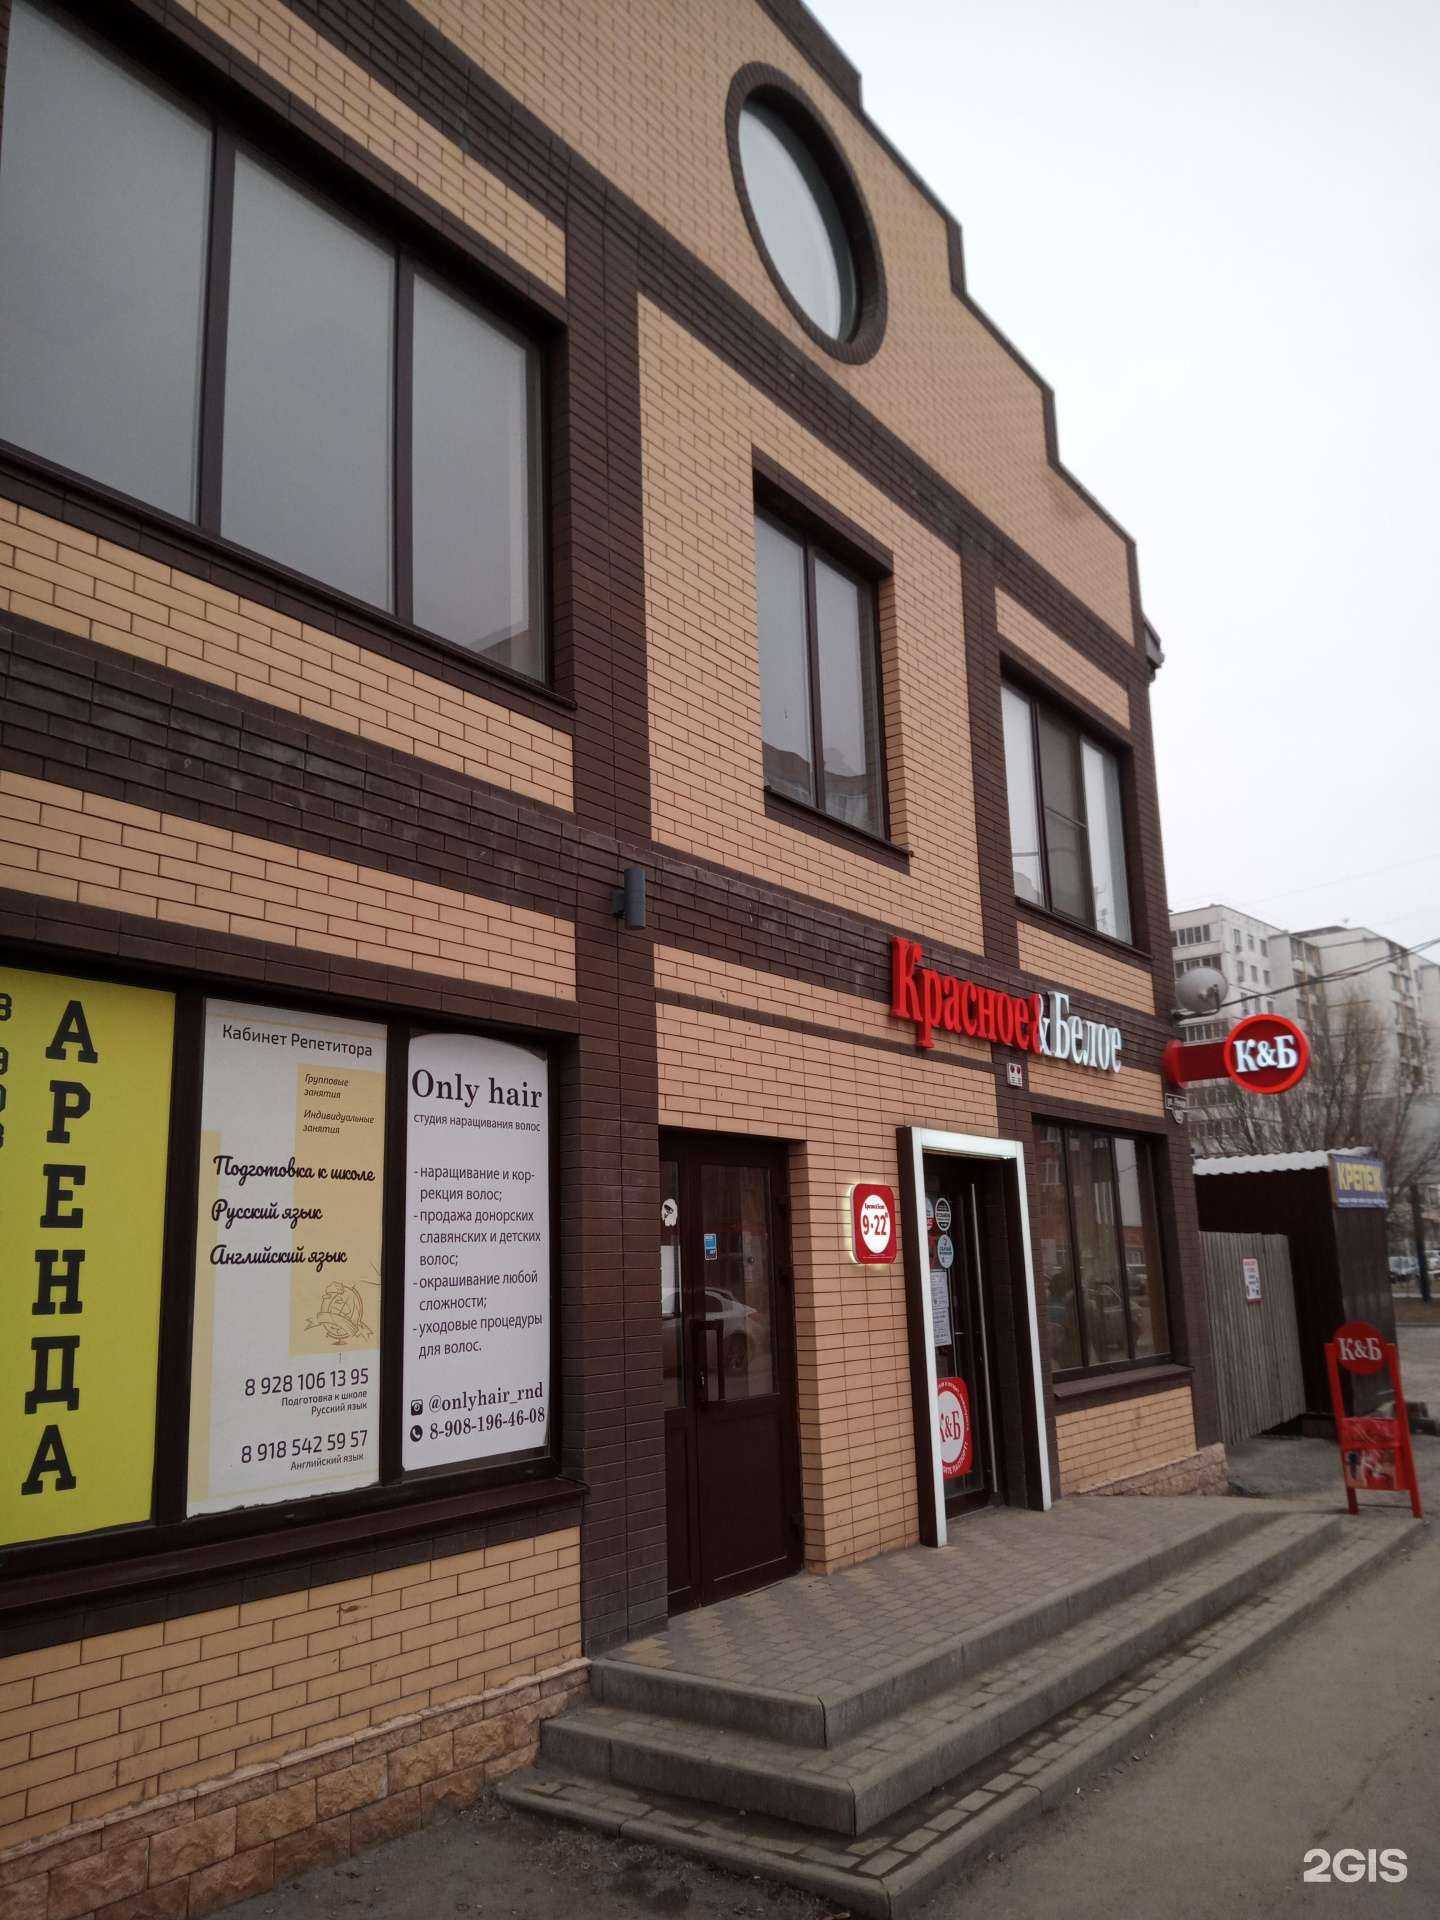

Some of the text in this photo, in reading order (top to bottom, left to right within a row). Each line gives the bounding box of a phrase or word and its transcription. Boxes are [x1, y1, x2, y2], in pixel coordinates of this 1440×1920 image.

[222, 1024, 372, 1058] Кабинет Репетитора
[1233, 1035, 1298, 1072] К&Б
[304, 1073, 349, 1087] Групповые
[412, 1069, 542, 1108] Only hair
[303, 1088, 341, 1099] занятия
[303, 1109, 375, 1125] Индивидуальные
[413, 1114, 541, 1131] студия наращивания волос
[303, 1125, 340, 1135] занятия
[213, 1155, 376, 1186] Подготовка к школе
[503, 1170, 510, 1180] и
[512, 1170, 535, 1183] кор-
[420, 1188, 502, 1202] рекция волос;
[211, 1198, 323, 1230] Русский язык
[475, 1211, 534, 1224] донорских
[420, 1231, 541, 1244] славянских и детских
[21, 1000, 98, 1495] АРЕНДА
[210, 1244, 348, 1272] Английский язык
[420, 1254, 458, 1266] волос;
[502, 1270, 538, 1284] любой
[419, 1297, 487, 1311] сложности;
[480, 1314, 542, 1331] процедуры
[419, 1341, 482, 1360] для волос.
[1337, 1337, 1382, 1361] К&Б
[245, 1368, 369, 1396] 8 928 106 13 95
[282, 1394, 333, 1406] Подготовка
[341, 1390, 368, 1399] школе
[429, 1382, 543, 1413] @onlyhair_rnd
[311, 1402, 368, 1416] Русский язык
[430, 1407, 545, 1440] 8-908-196-46-08
[241, 1430, 368, 1463] 8 918 542 59 57
[290, 1454, 364, 1471] Английский язык
